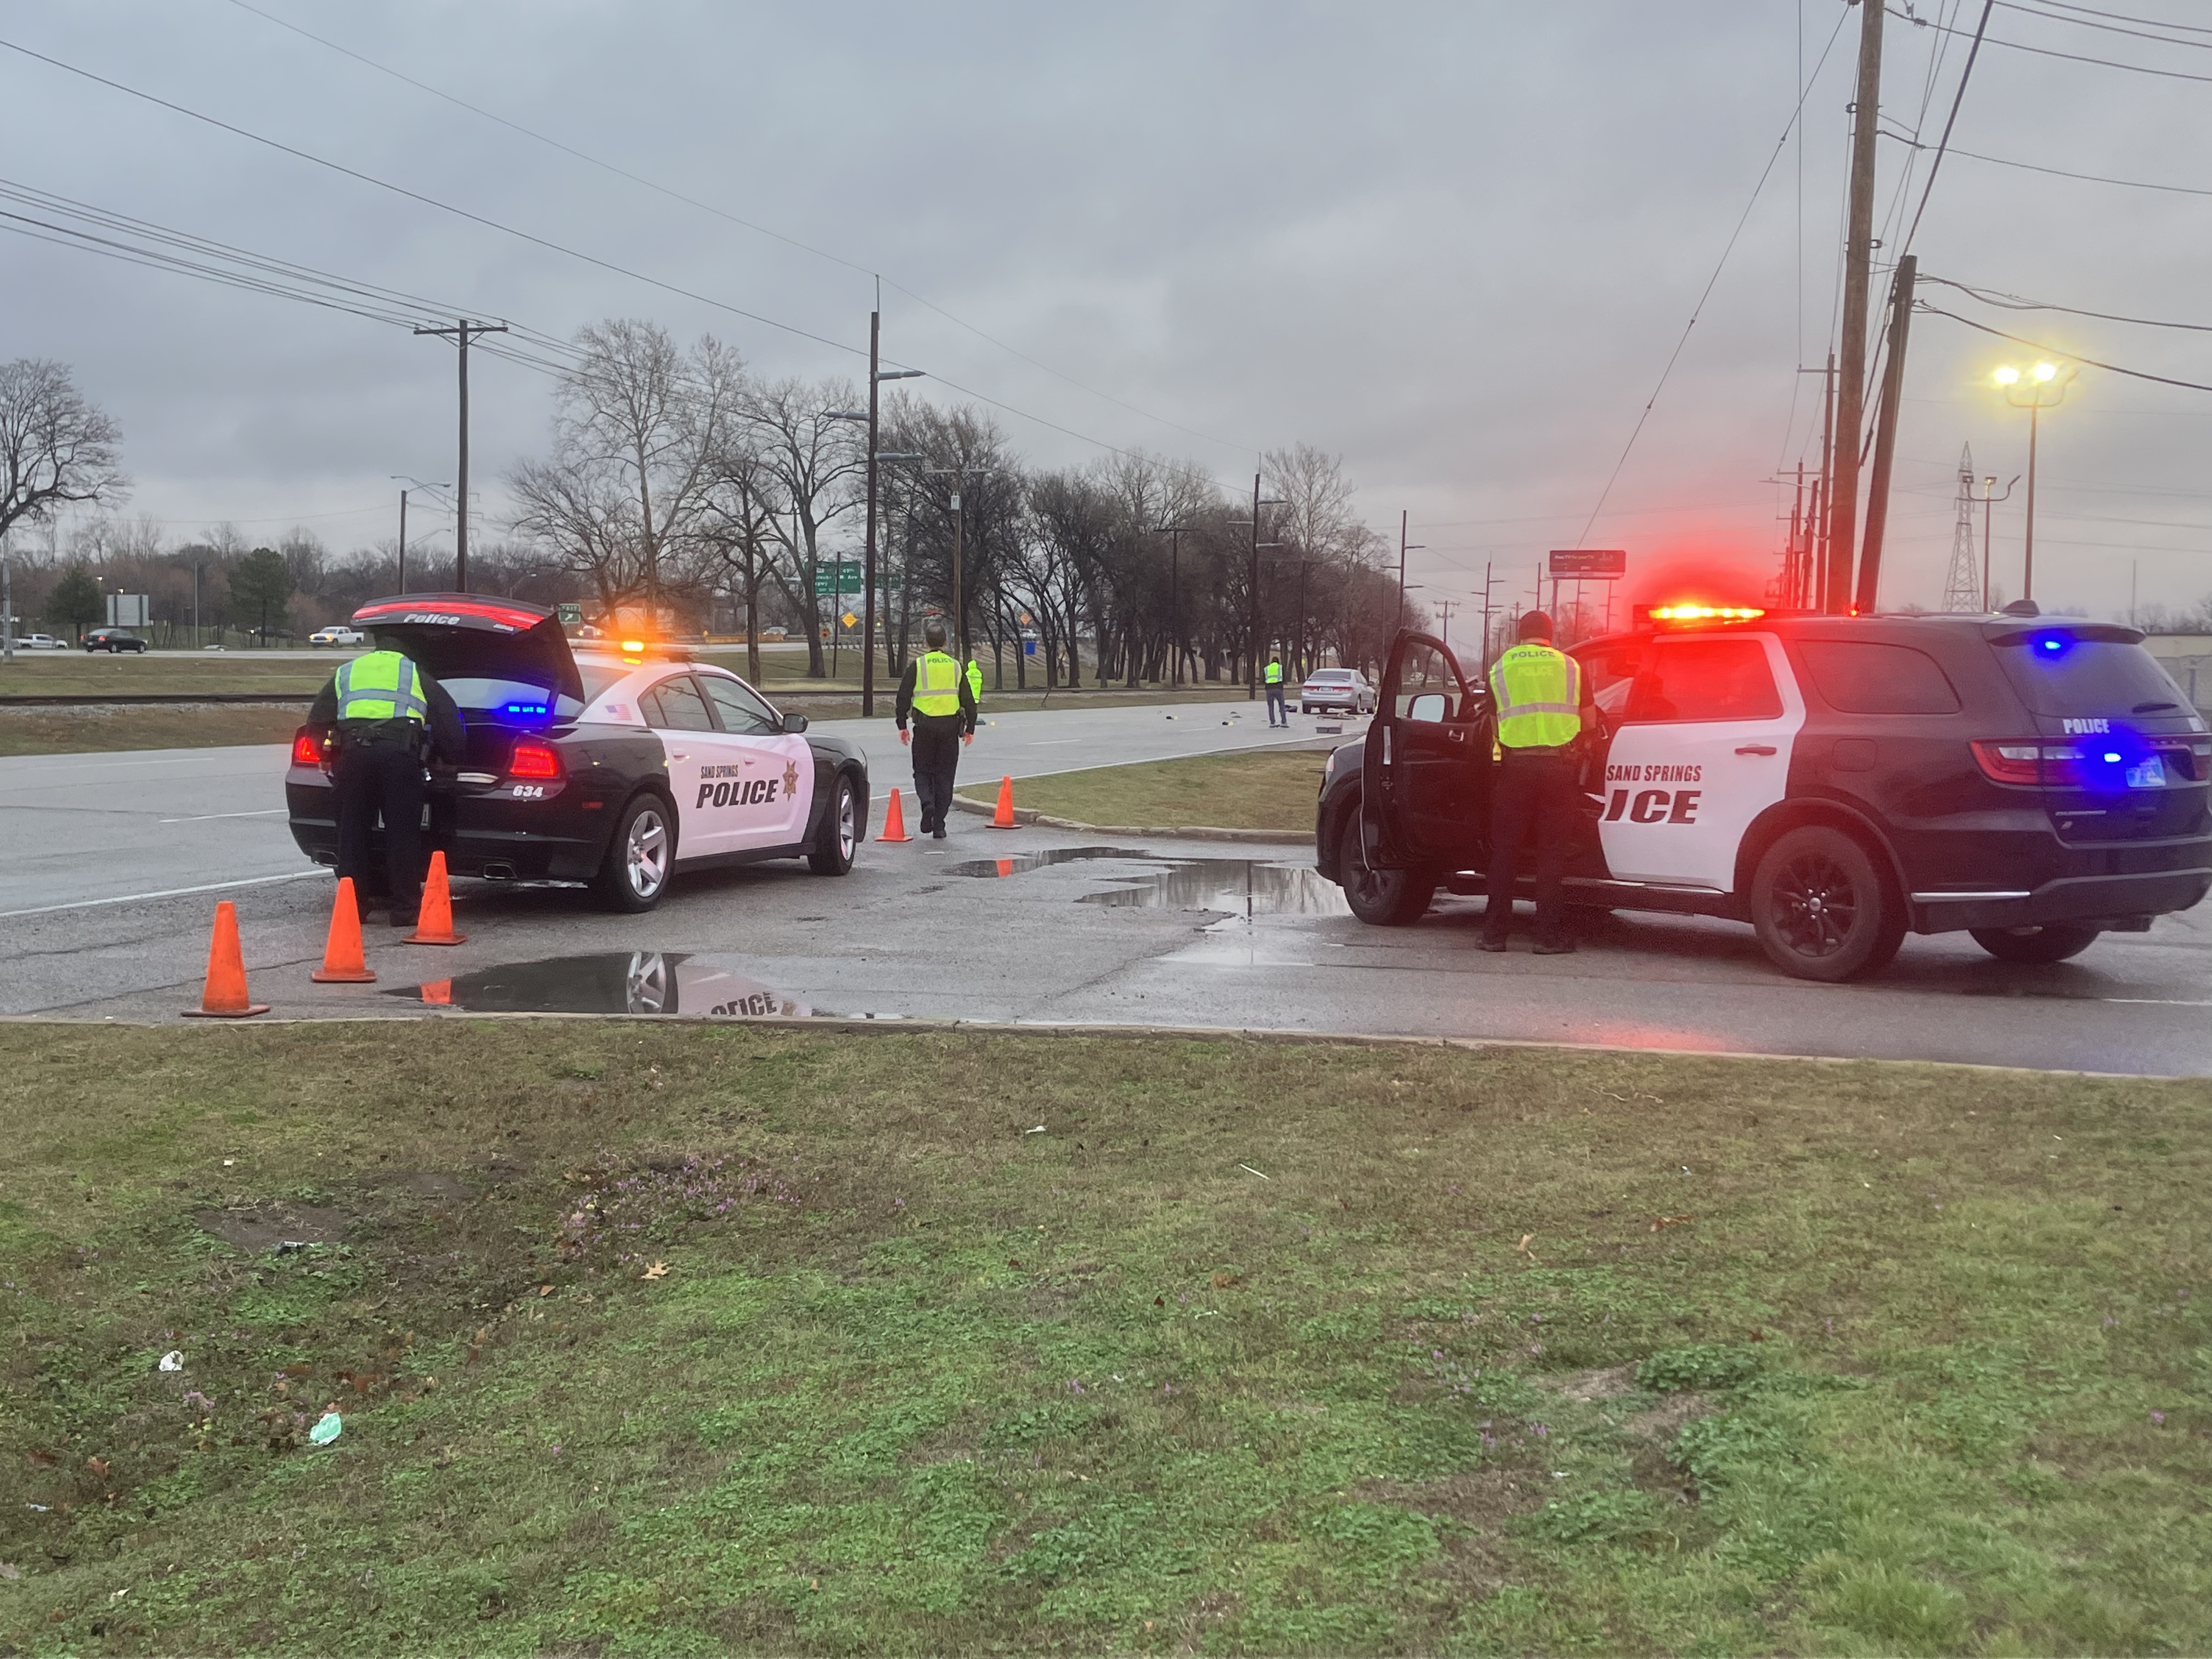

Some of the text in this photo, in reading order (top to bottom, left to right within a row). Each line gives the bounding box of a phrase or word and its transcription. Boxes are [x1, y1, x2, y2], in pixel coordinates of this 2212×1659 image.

[403, 613, 460, 625] Police
[1511, 651, 1555, 660] POLICE
[1517, 665, 1554, 676] POLICE
[2063, 718, 2110, 734] POLICE
[701, 765, 738, 779] SAND SPRINGS
[1606, 765, 1702, 782] SAND SPRINGS
[512, 785, 544, 798] 634
[696, 779, 779, 809] POLICE
